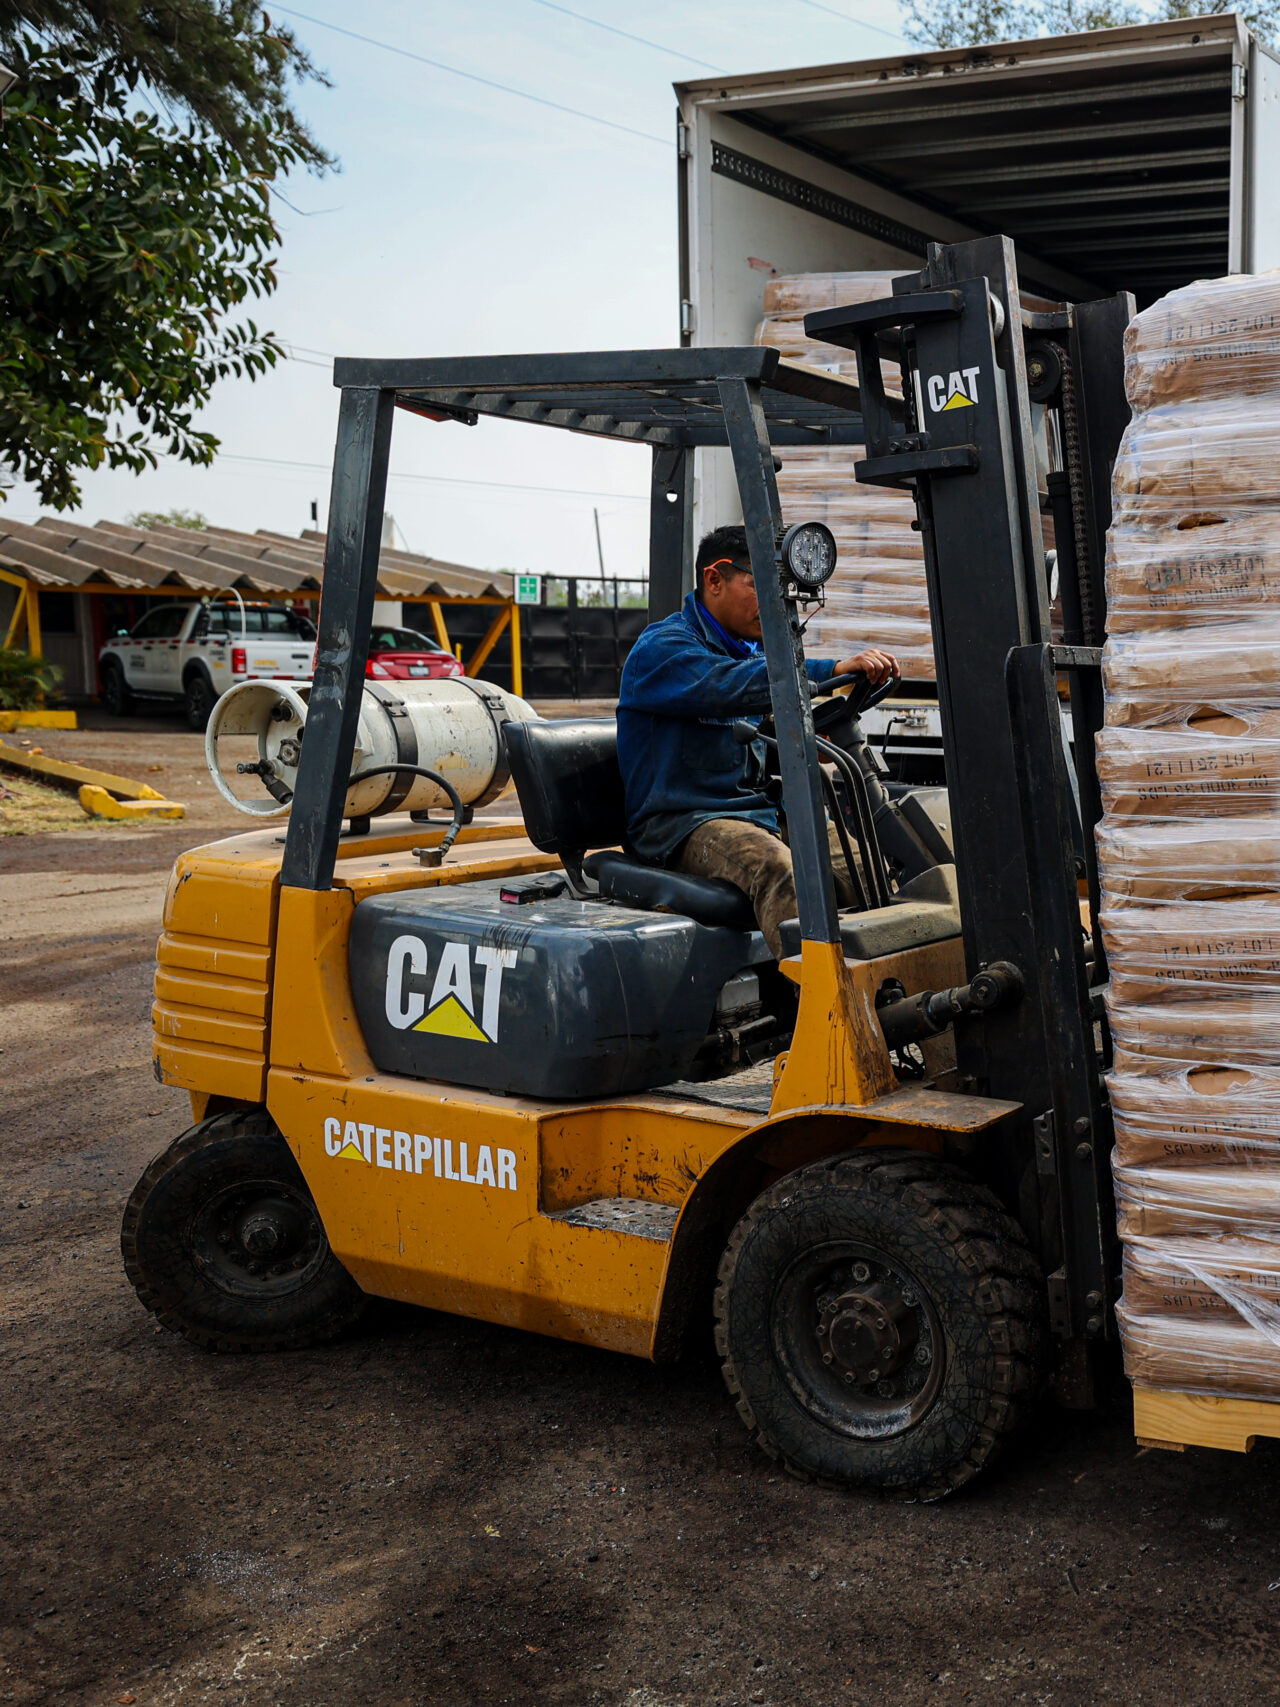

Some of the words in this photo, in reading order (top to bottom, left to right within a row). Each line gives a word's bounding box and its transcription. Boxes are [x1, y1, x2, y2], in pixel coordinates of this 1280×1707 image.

[928, 366, 980, 413] CAT
[1146, 756, 1218, 776] 2511121
[1224, 752, 1255, 768] LOT
[1138, 785, 1168, 800] LBS
[1164, 941, 1236, 960] 2511121
[1242, 938, 1272, 953] LOT
[385, 935, 518, 1044] CAT
[324, 1117, 518, 1191] CATERPILLAR
[1163, 1143, 1195, 1155] LBS
[1162, 1295, 1192, 1307] LBS
